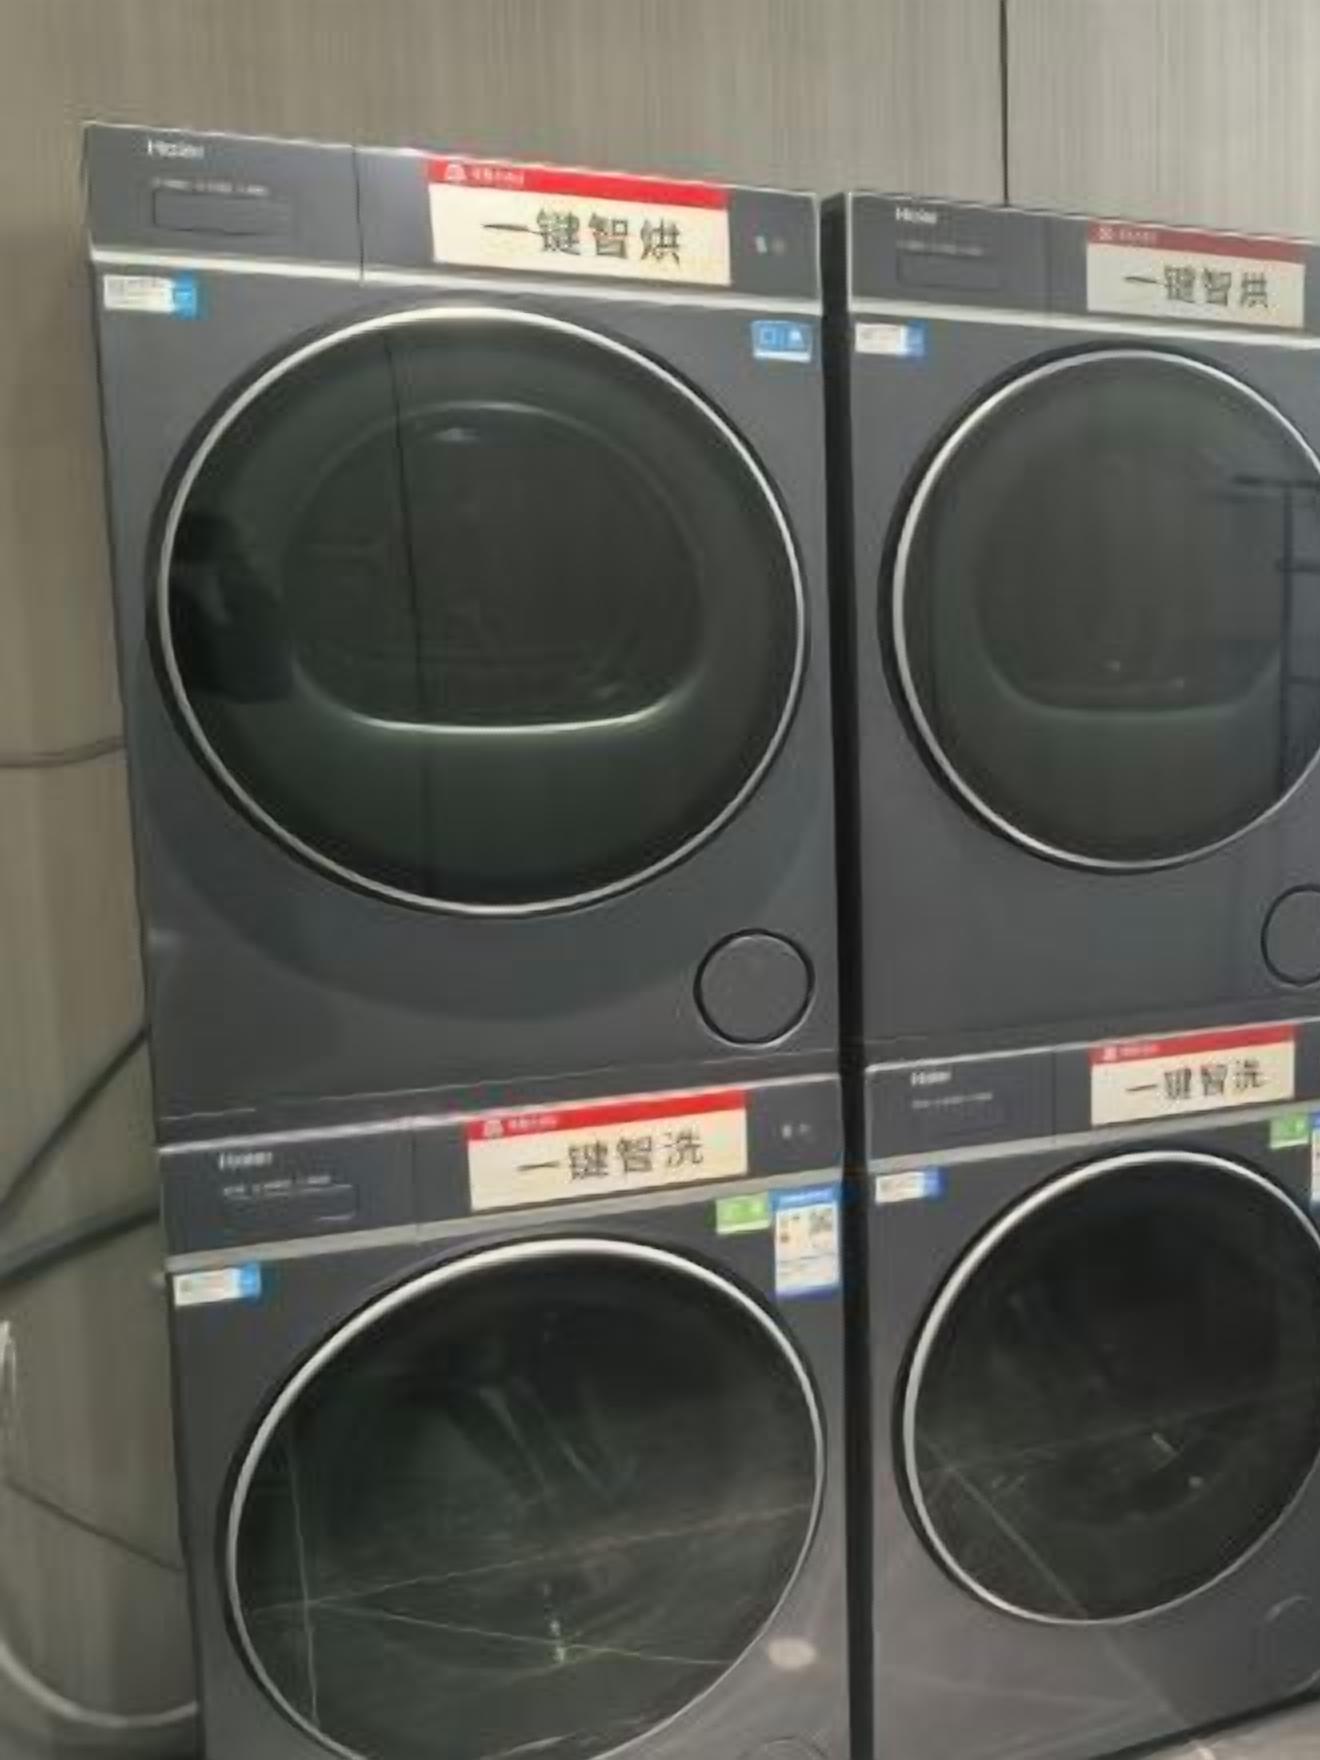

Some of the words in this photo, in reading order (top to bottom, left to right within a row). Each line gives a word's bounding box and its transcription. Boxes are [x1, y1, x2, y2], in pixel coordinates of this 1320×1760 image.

[480, 207, 681, 266] 一键智烘
[1123, 263, 1269, 309] 一键智烘
[516, 1128, 704, 1181] 一键智洗
